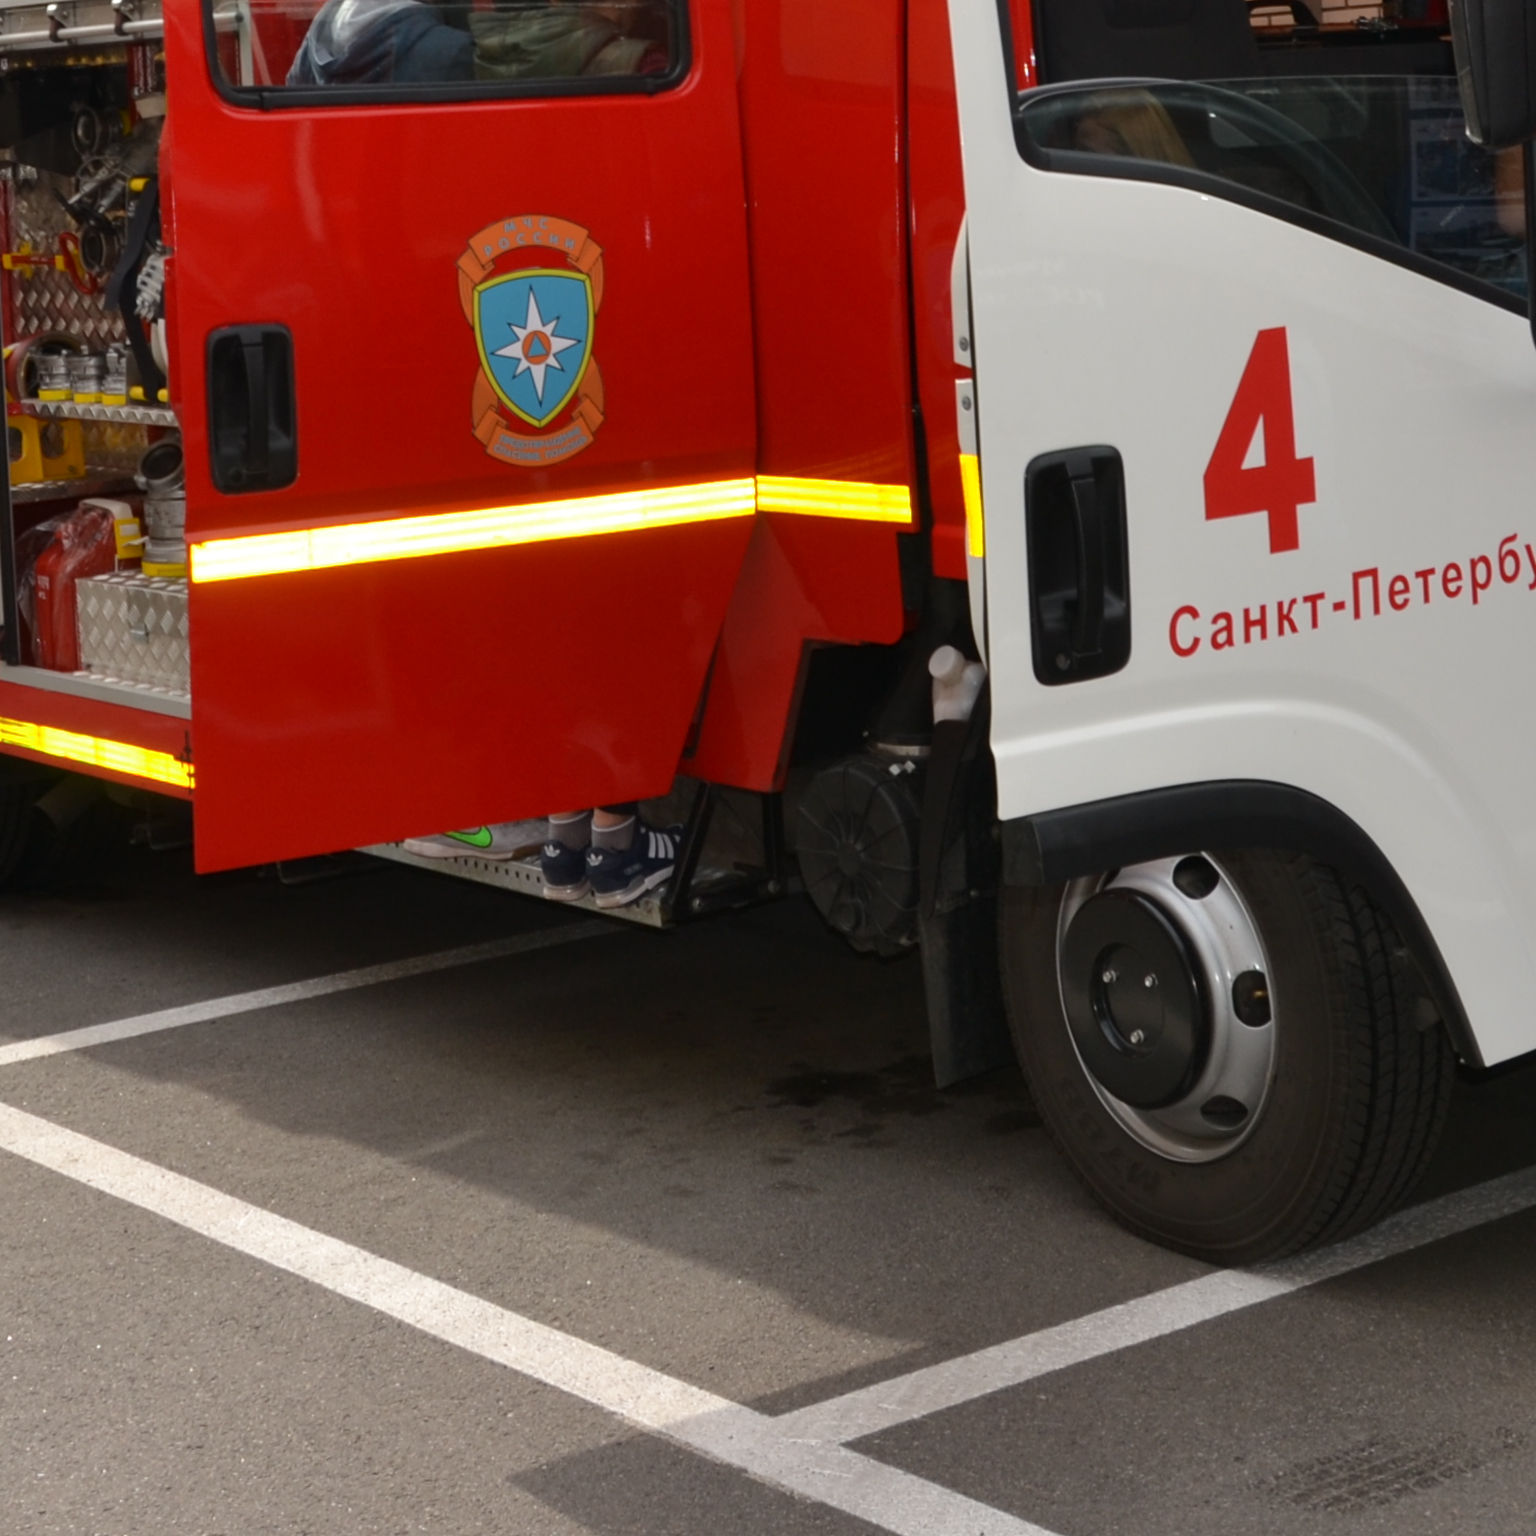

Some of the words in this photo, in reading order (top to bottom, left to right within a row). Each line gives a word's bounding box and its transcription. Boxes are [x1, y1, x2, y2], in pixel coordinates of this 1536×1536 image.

[504, 216, 549, 234] МЧС
[483, 231, 577, 257] РОССИИ
[1203, 325, 1316, 555] 4
